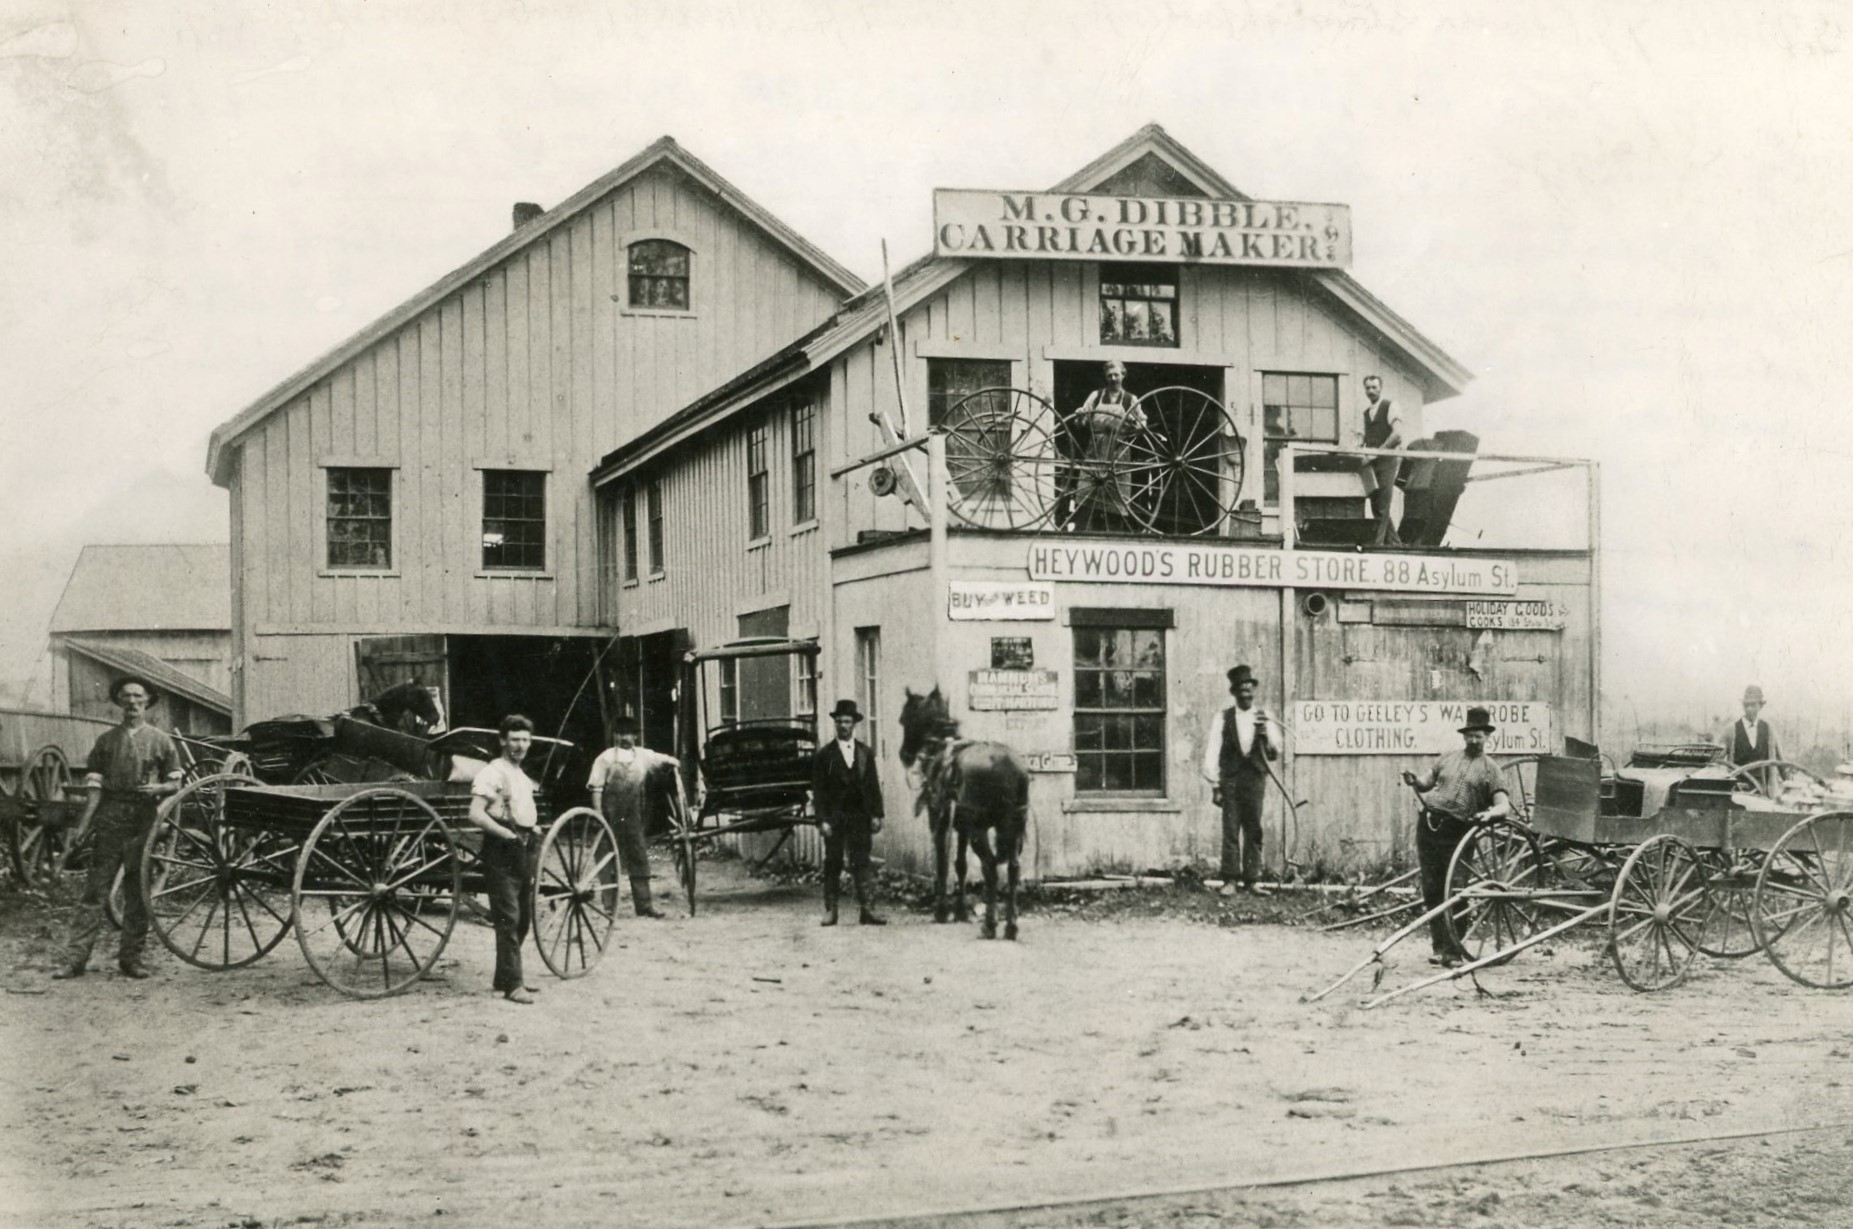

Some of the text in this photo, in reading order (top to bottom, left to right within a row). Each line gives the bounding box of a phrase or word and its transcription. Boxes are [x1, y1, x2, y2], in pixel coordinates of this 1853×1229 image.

[939, 222, 1167, 256] CARRIAGE
[1035, 547, 1174, 578] HEYWOOD'S
[1187, 552, 1282, 580] RUBBER
[1383, 560, 1410, 585] 88
[1416, 561, 1482, 590] Asylum
[951, 591, 986, 609] BUY
[1002, 589, 1050, 606] WEED
[1468, 601, 1508, 616] HOLIDAY
[1515, 602, 1554, 617] GOODS
[1469, 616, 1503, 627] COOKS
[1303, 704, 1325, 722] GO
[1330, 704, 1350, 722] TO
[1439, 704, 1531, 723] WAROBE
[1485, 731, 1524, 752] sylum
